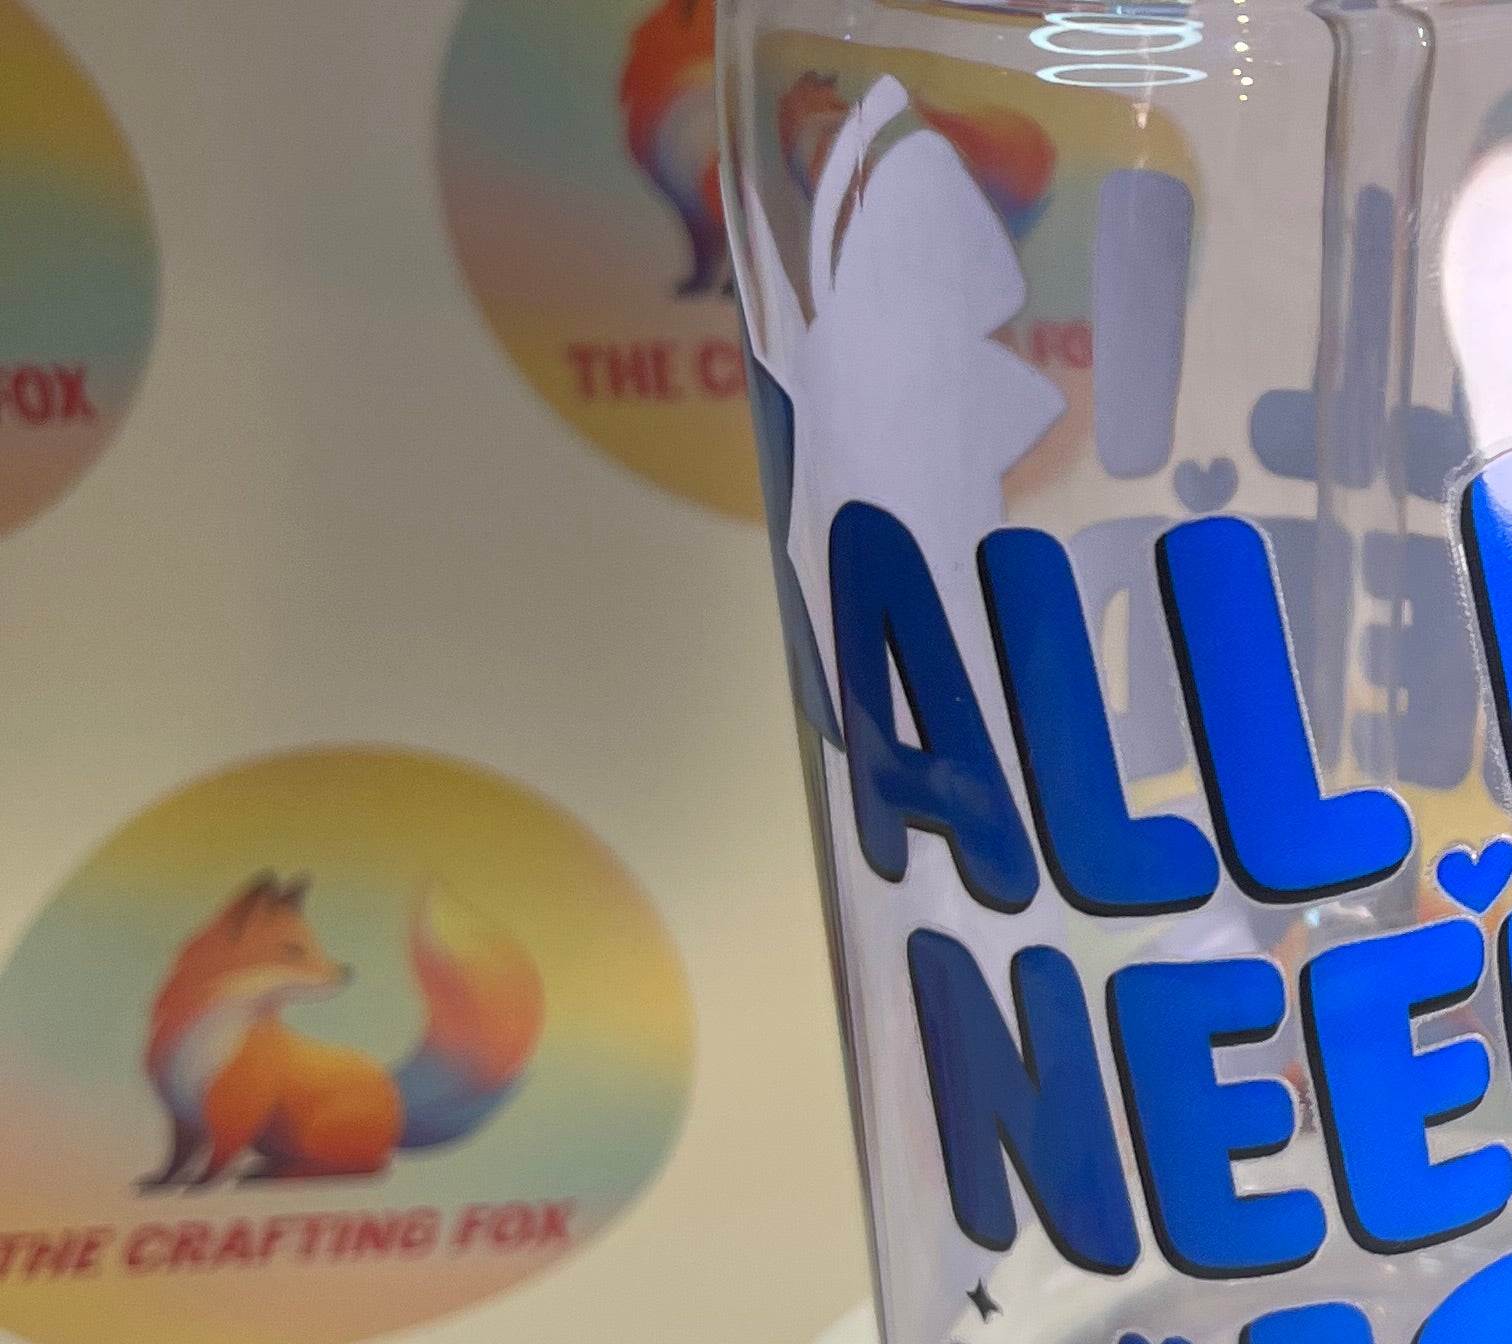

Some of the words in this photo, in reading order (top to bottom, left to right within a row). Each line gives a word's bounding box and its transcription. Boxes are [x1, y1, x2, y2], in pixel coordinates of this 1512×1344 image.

[567, 340, 682, 402] THE
[829, 498, 1414, 917] ALL
[0, 1226, 114, 1282] THE
[123, 1206, 440, 1276] CRAFTING
[451, 1198, 577, 1253] FOX
